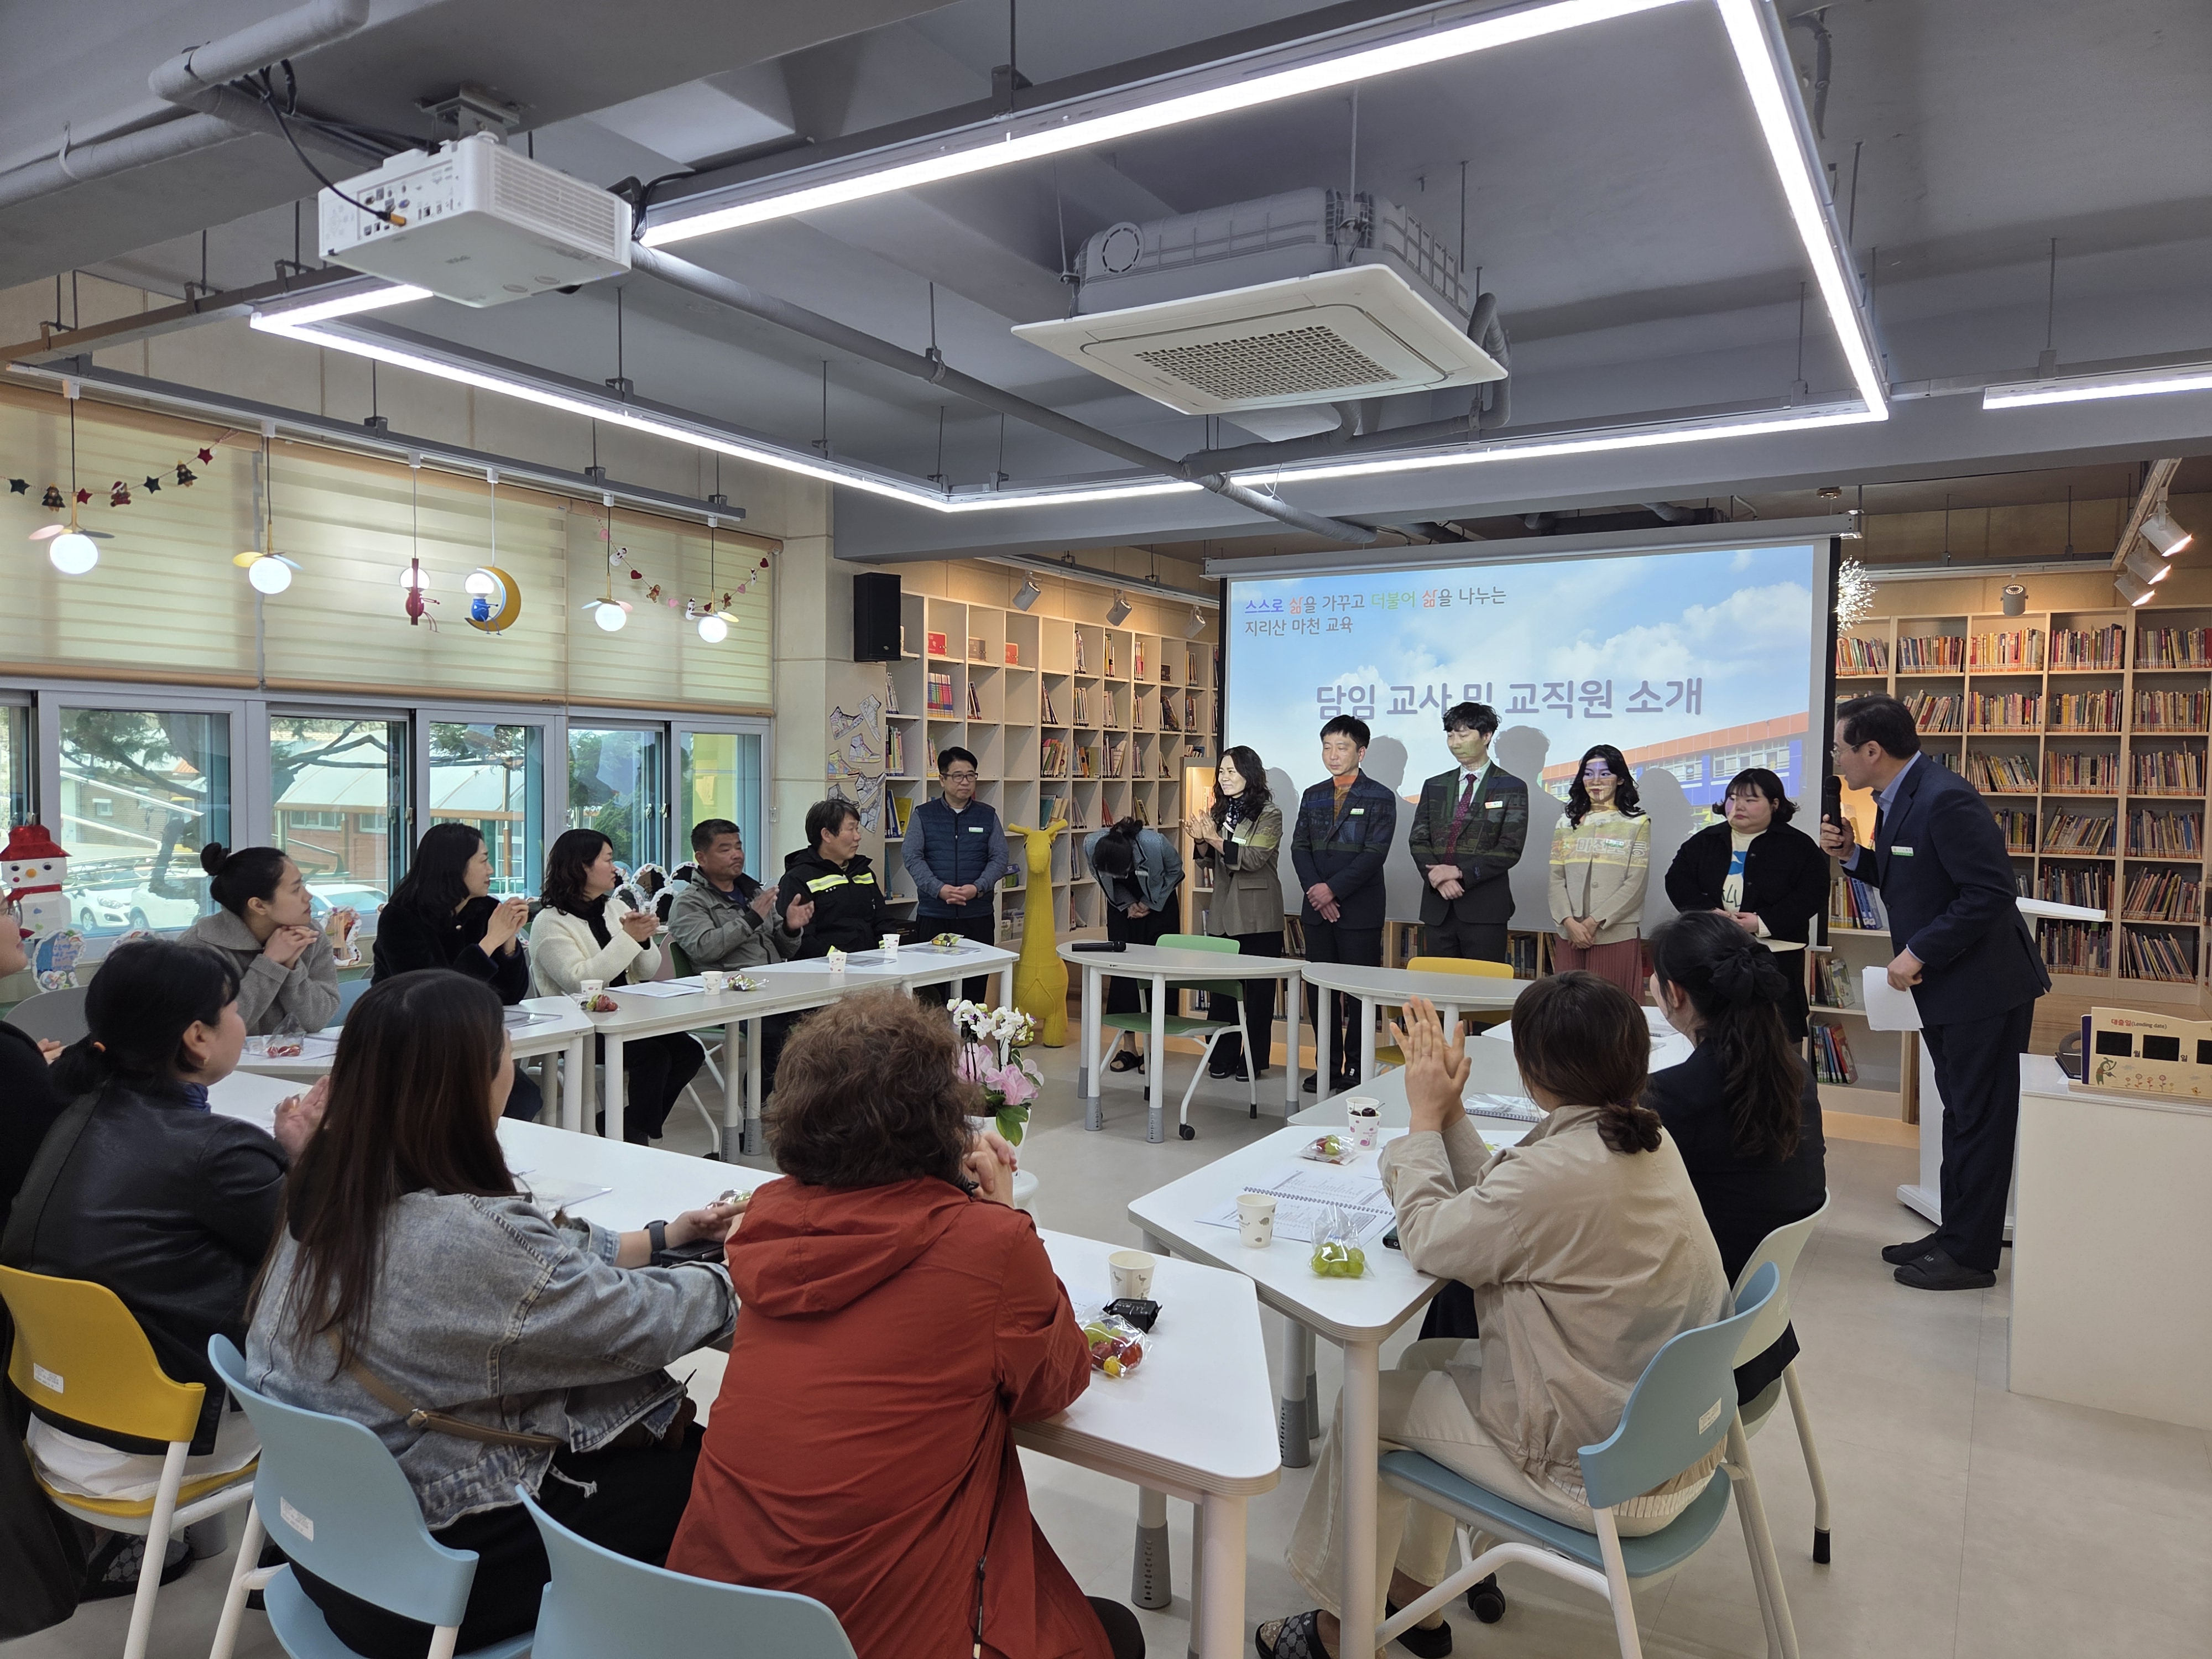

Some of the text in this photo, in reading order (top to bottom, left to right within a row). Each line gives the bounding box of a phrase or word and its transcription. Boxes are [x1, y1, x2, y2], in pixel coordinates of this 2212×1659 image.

[1244, 586, 1506, 614] 스스로 삶을 가꾸고 더불어 삶을 나누는
[1244, 616, 1353, 637] 지리산 마천 교육
[1316, 684, 1375, 720] 담임
[1386, 682, 1452, 715] 교사
[1504, 679, 1613, 719] 교직원
[1625, 677, 1703, 715] 소개
